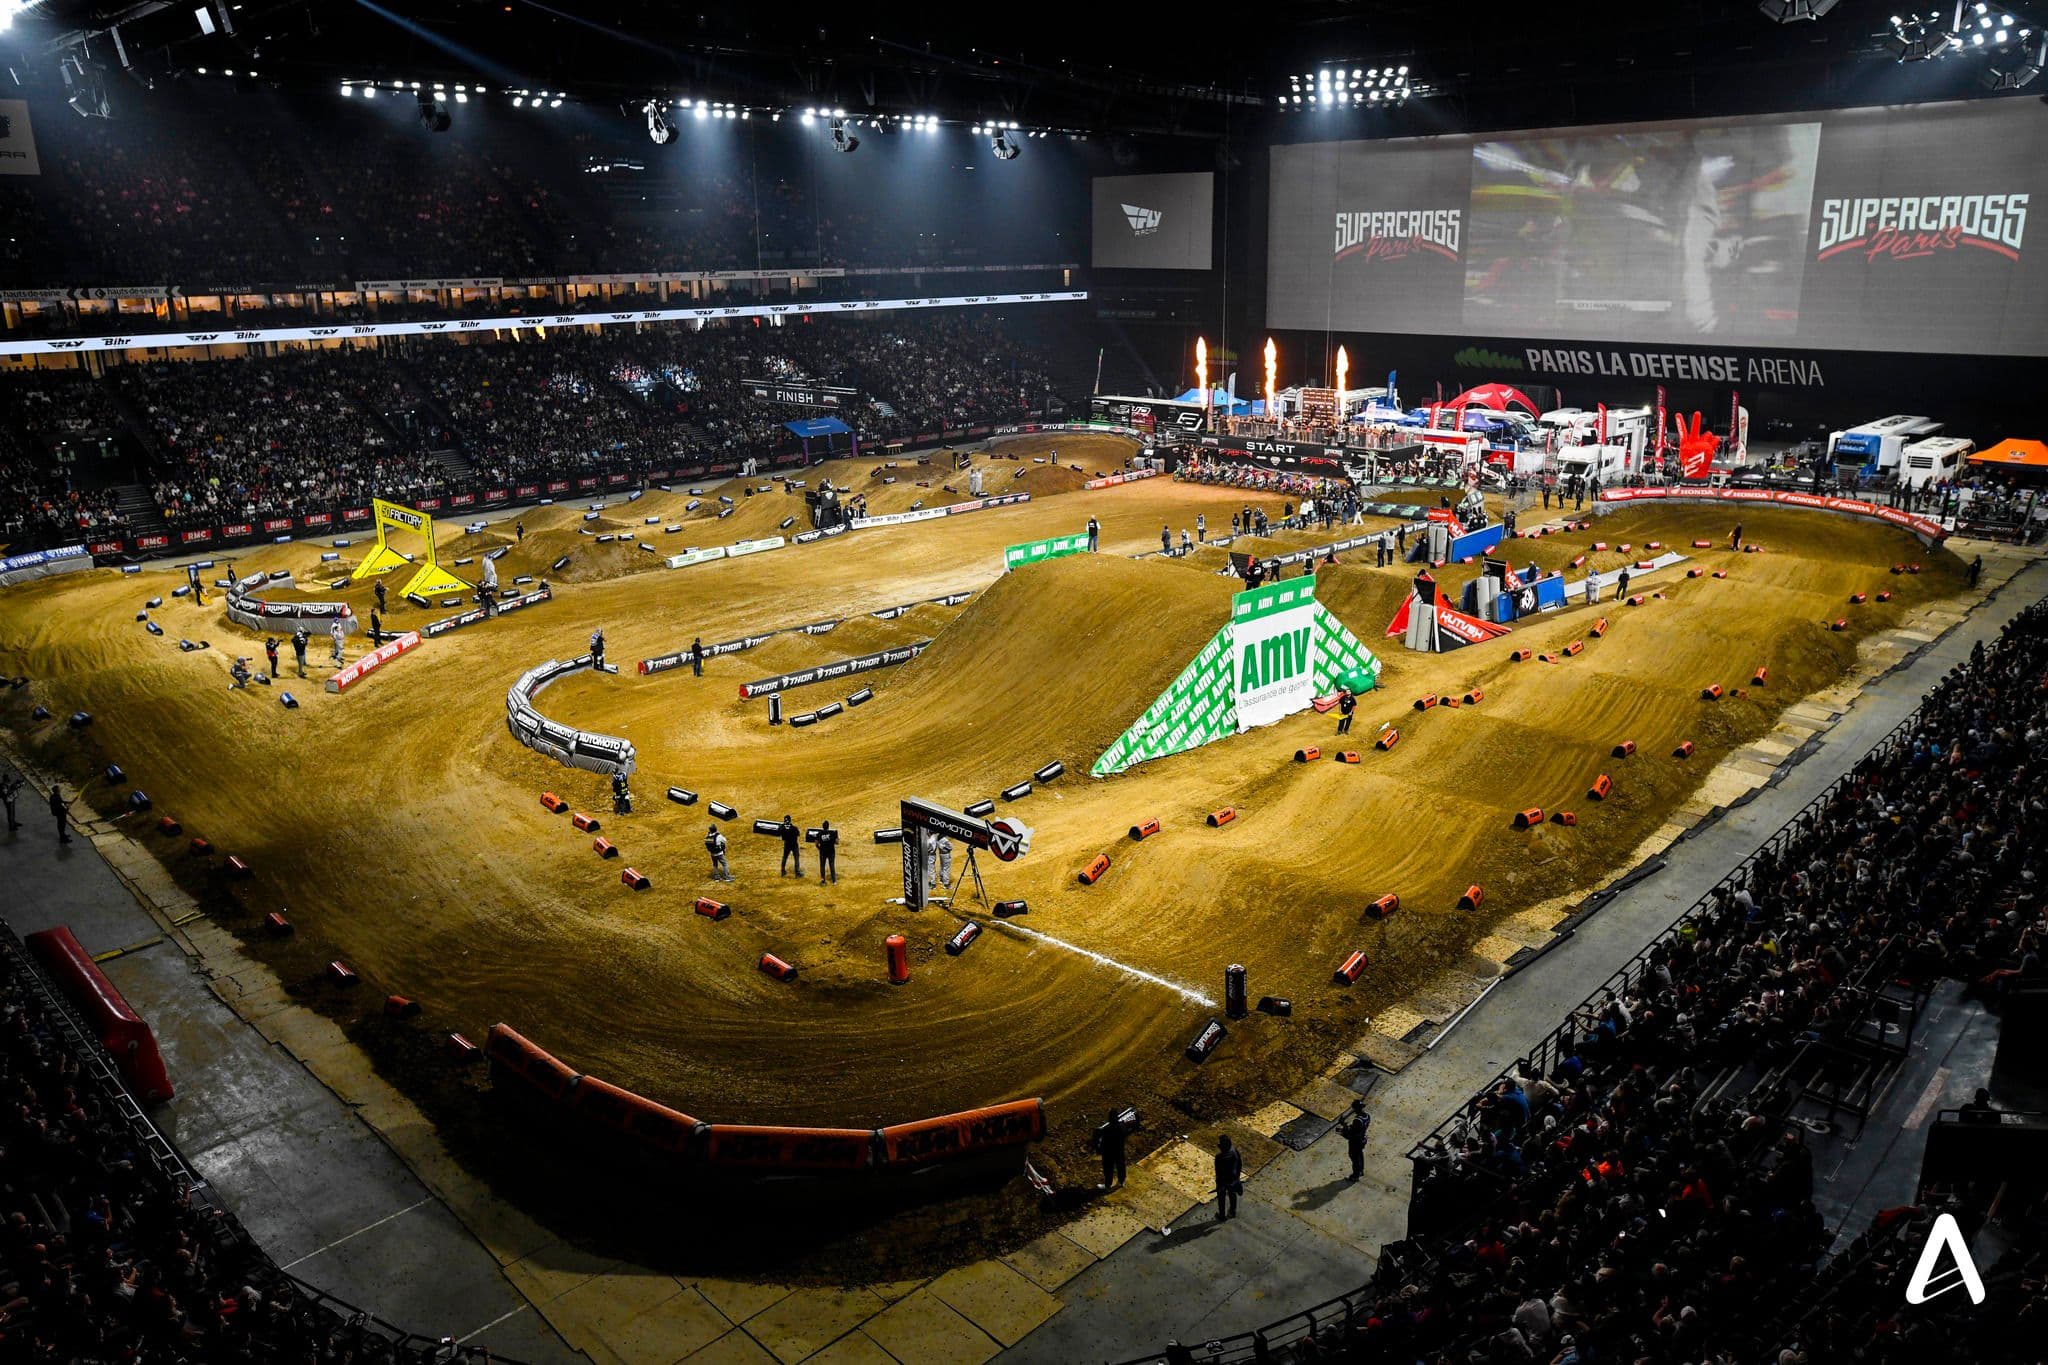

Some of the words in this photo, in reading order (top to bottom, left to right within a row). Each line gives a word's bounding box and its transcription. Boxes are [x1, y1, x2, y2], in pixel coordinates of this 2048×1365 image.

[1819, 194, 2029, 250] SUPERCROSS
[1335, 210, 1460, 253] SUPERCROSS
[1365, 235, 1424, 263] Paris
[1867, 225, 1963, 263] Paris
[460, 320, 480, 328] Bihr
[235, 331, 261, 340] Bihr
[353, 326, 376, 334] Bihr
[102, 336, 131, 346] Bihr
[1526, 348, 1595, 375] PARIS
[1597, 351, 1628, 377] LA
[1630, 353, 1741, 382] DEFENSE
[1747, 358, 1825, 387] ARENA
[776, 391, 814, 404] FINISH
[1246, 441, 1296, 454] START
[521, 487, 534, 495] RMC
[455, 495, 470, 503] RMC
[1787, 495, 1821, 505] HONDA
[421, 501, 436, 509] RMC
[1839, 502, 1871, 513] HONDA
[349, 509, 365, 517] RMC
[310, 515, 327, 523] RMC
[229, 525, 247, 534] RMC
[270, 521, 288, 529] RMC
[188, 531, 206, 540] RMC
[97, 543, 117, 551] RMC
[144, 537, 163, 546] RMC
[55, 545, 84, 557] YAMAHA
[16, 554, 44, 568] YAMAHA
[525, 591, 549, 604] RFX
[265, 604, 292, 615] TRIUMPH
[302, 604, 335, 615] TRIUMPH
[498, 601, 522, 612] RFX
[460, 609, 486, 624] RFX
[430, 621, 456, 633] RFX
[813, 624, 834, 633] THOR
[720, 643, 742, 654] THOR
[890, 650, 911, 661] THOR
[656, 657, 678, 668] THOR
[857, 657, 880, 668] THOR
[823, 664, 847, 677] THOR
[790, 673, 813, 685] THOR
[753, 681, 778, 695] THOR
[579, 734, 621, 751] AUTOMOTO
[929, 816, 973, 838] OXMOTO
[905, 840, 913, 897] HOLESHOT
